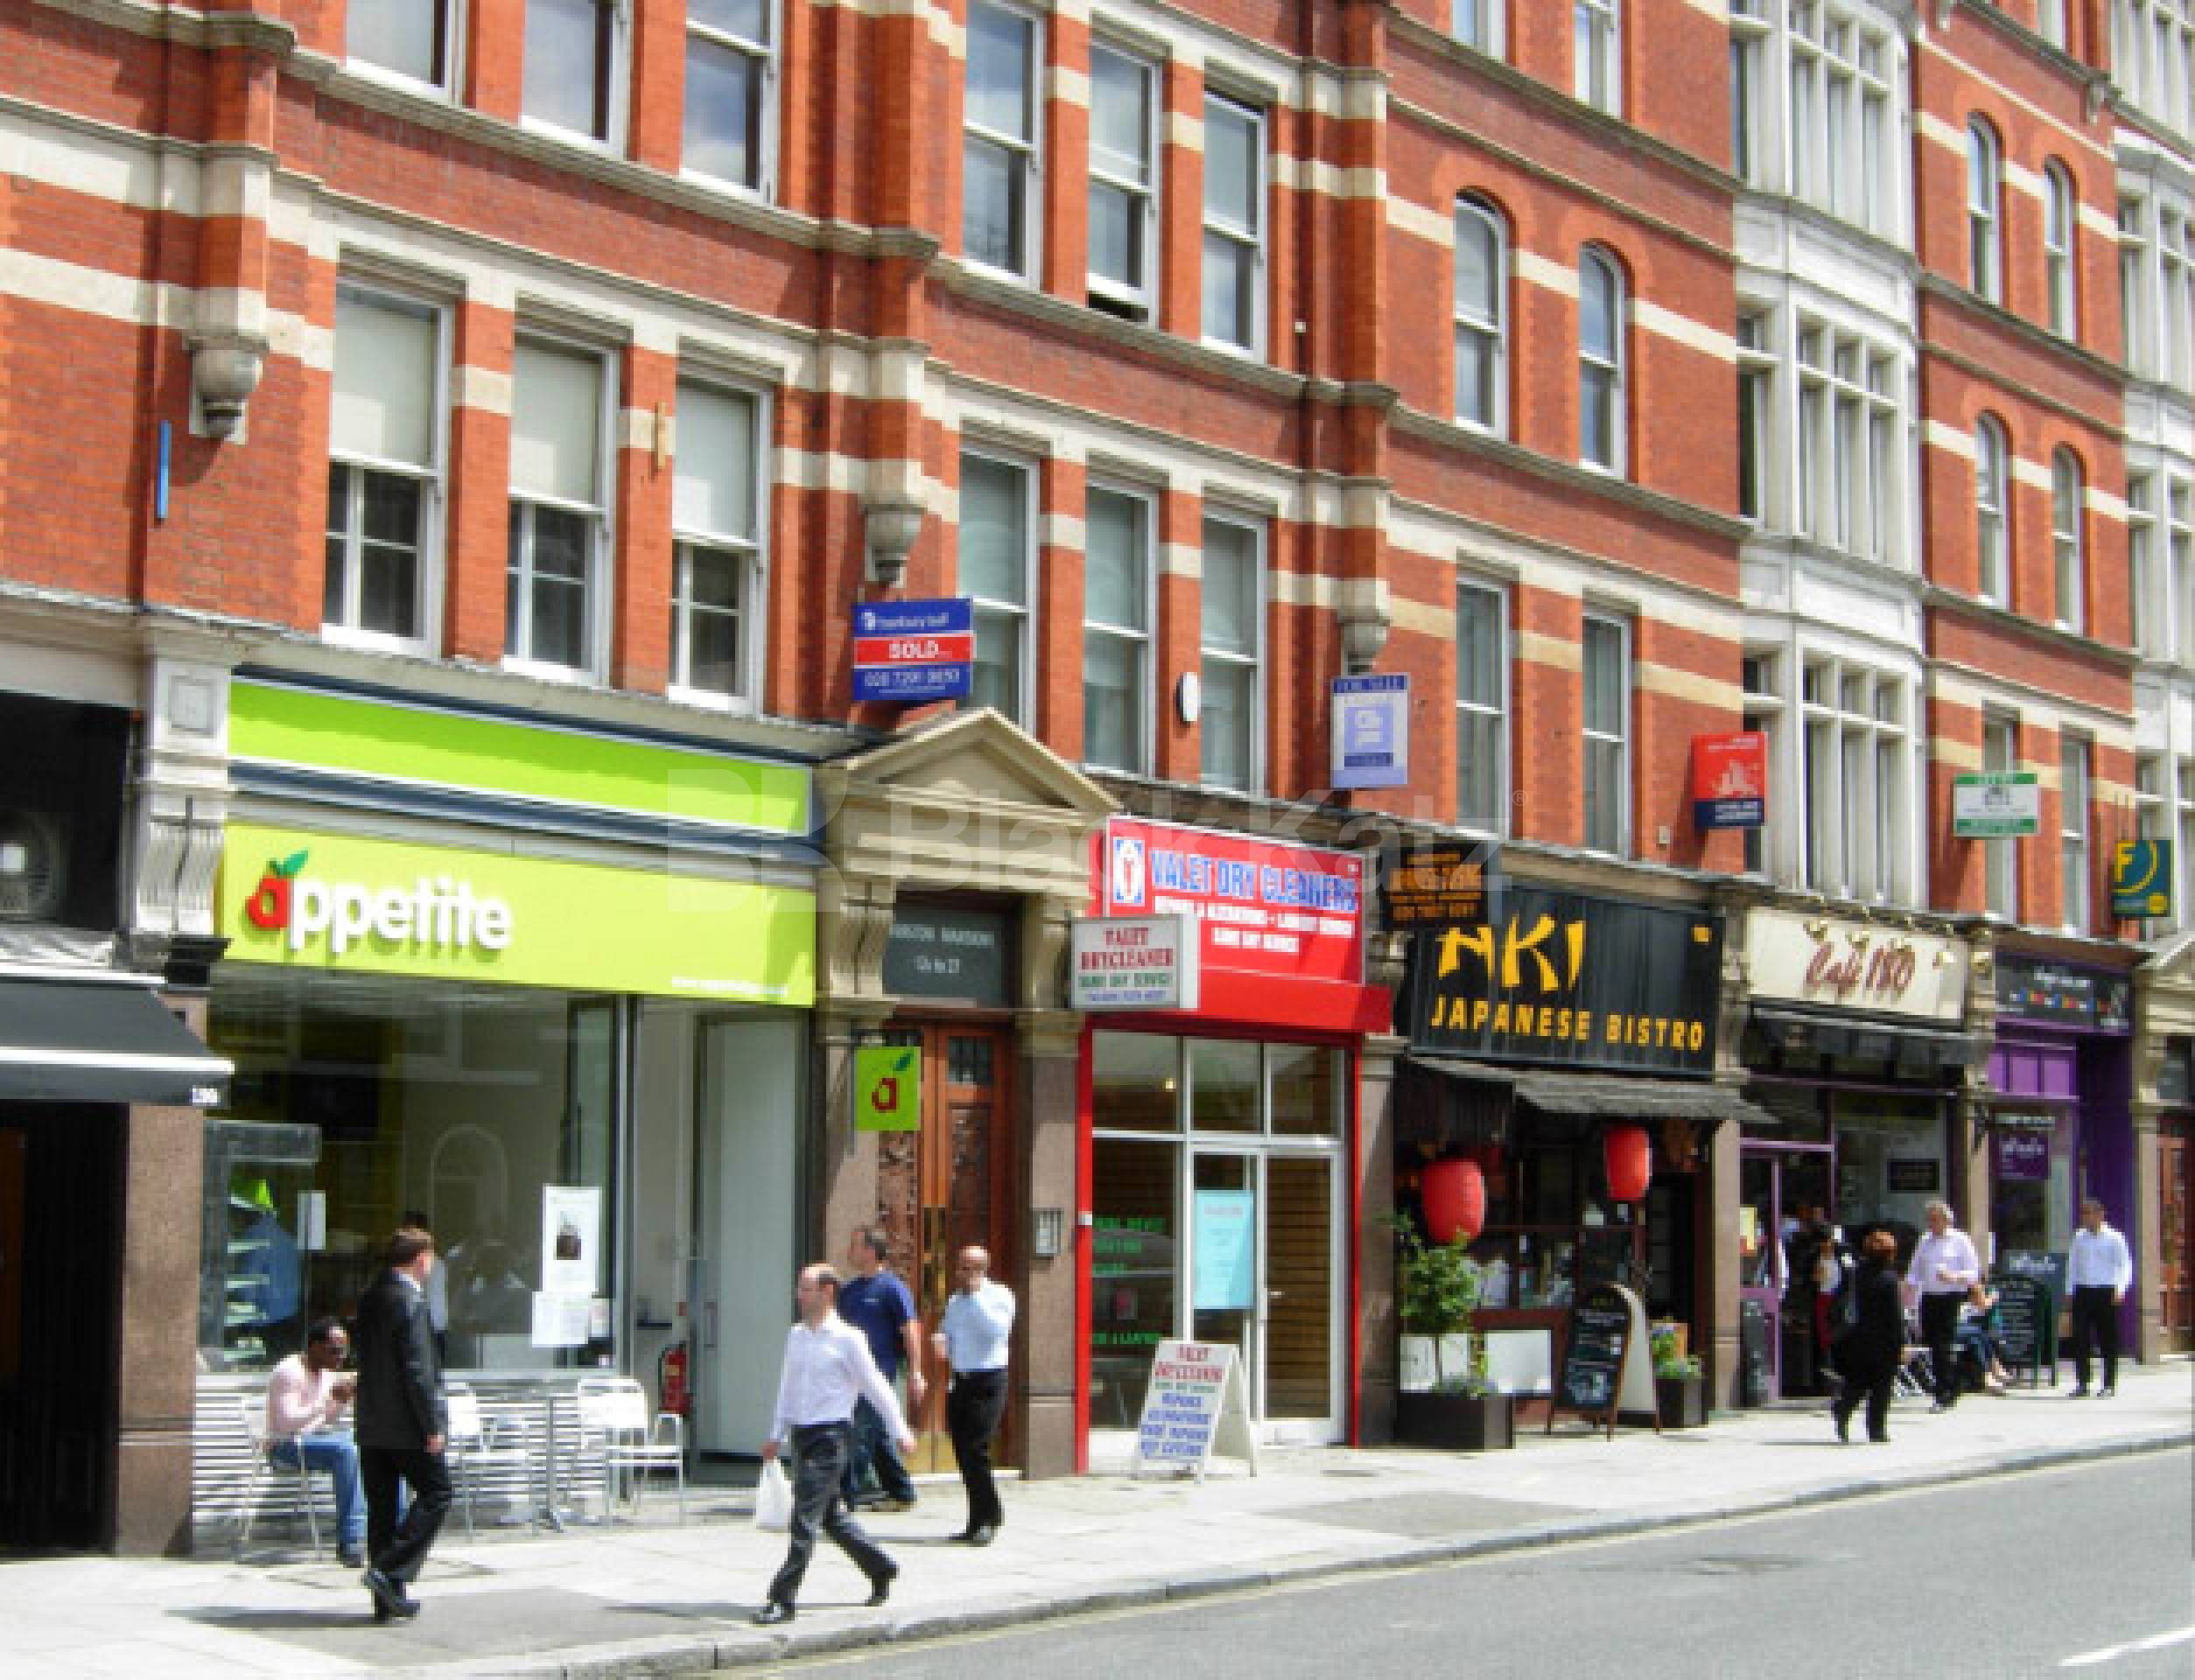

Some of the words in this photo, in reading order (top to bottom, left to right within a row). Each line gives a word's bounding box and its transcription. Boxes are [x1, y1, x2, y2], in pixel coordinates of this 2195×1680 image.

[889, 640, 939, 658] SOLD
[1151, 849, 1212, 893] VALET
[1217, 860, 1255, 900] DRY
[1260, 867, 1357, 913] CLEANERS
[244, 874, 512, 954] appetite
[1438, 914, 1587, 993] AKI
[1431, 994, 1590, 1041] JAPANESE
[1606, 1014, 1706, 1052] BISTRO
